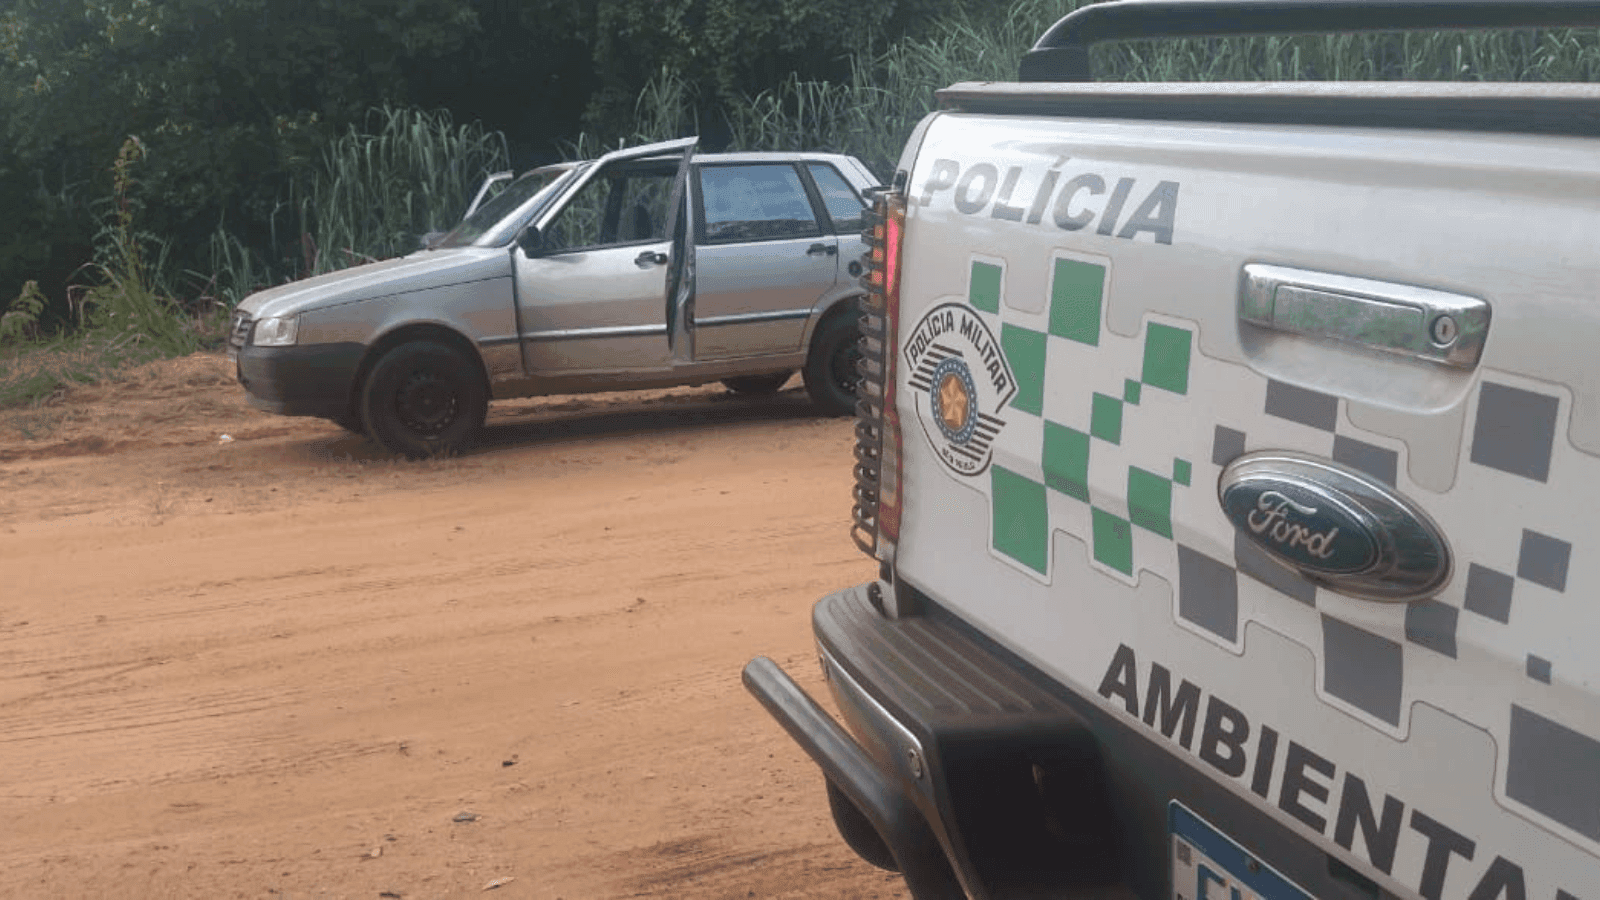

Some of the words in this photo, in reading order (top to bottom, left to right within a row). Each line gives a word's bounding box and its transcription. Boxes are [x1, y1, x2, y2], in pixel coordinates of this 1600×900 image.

[919, 155, 1180, 245] POLÍCIA
[909, 310, 955, 365] POLÍCIA
[959, 313, 1007, 395] MILITAR
[1248, 490, 1339, 559] Ford
[1098, 643, 1580, 900] AMBIENTA
